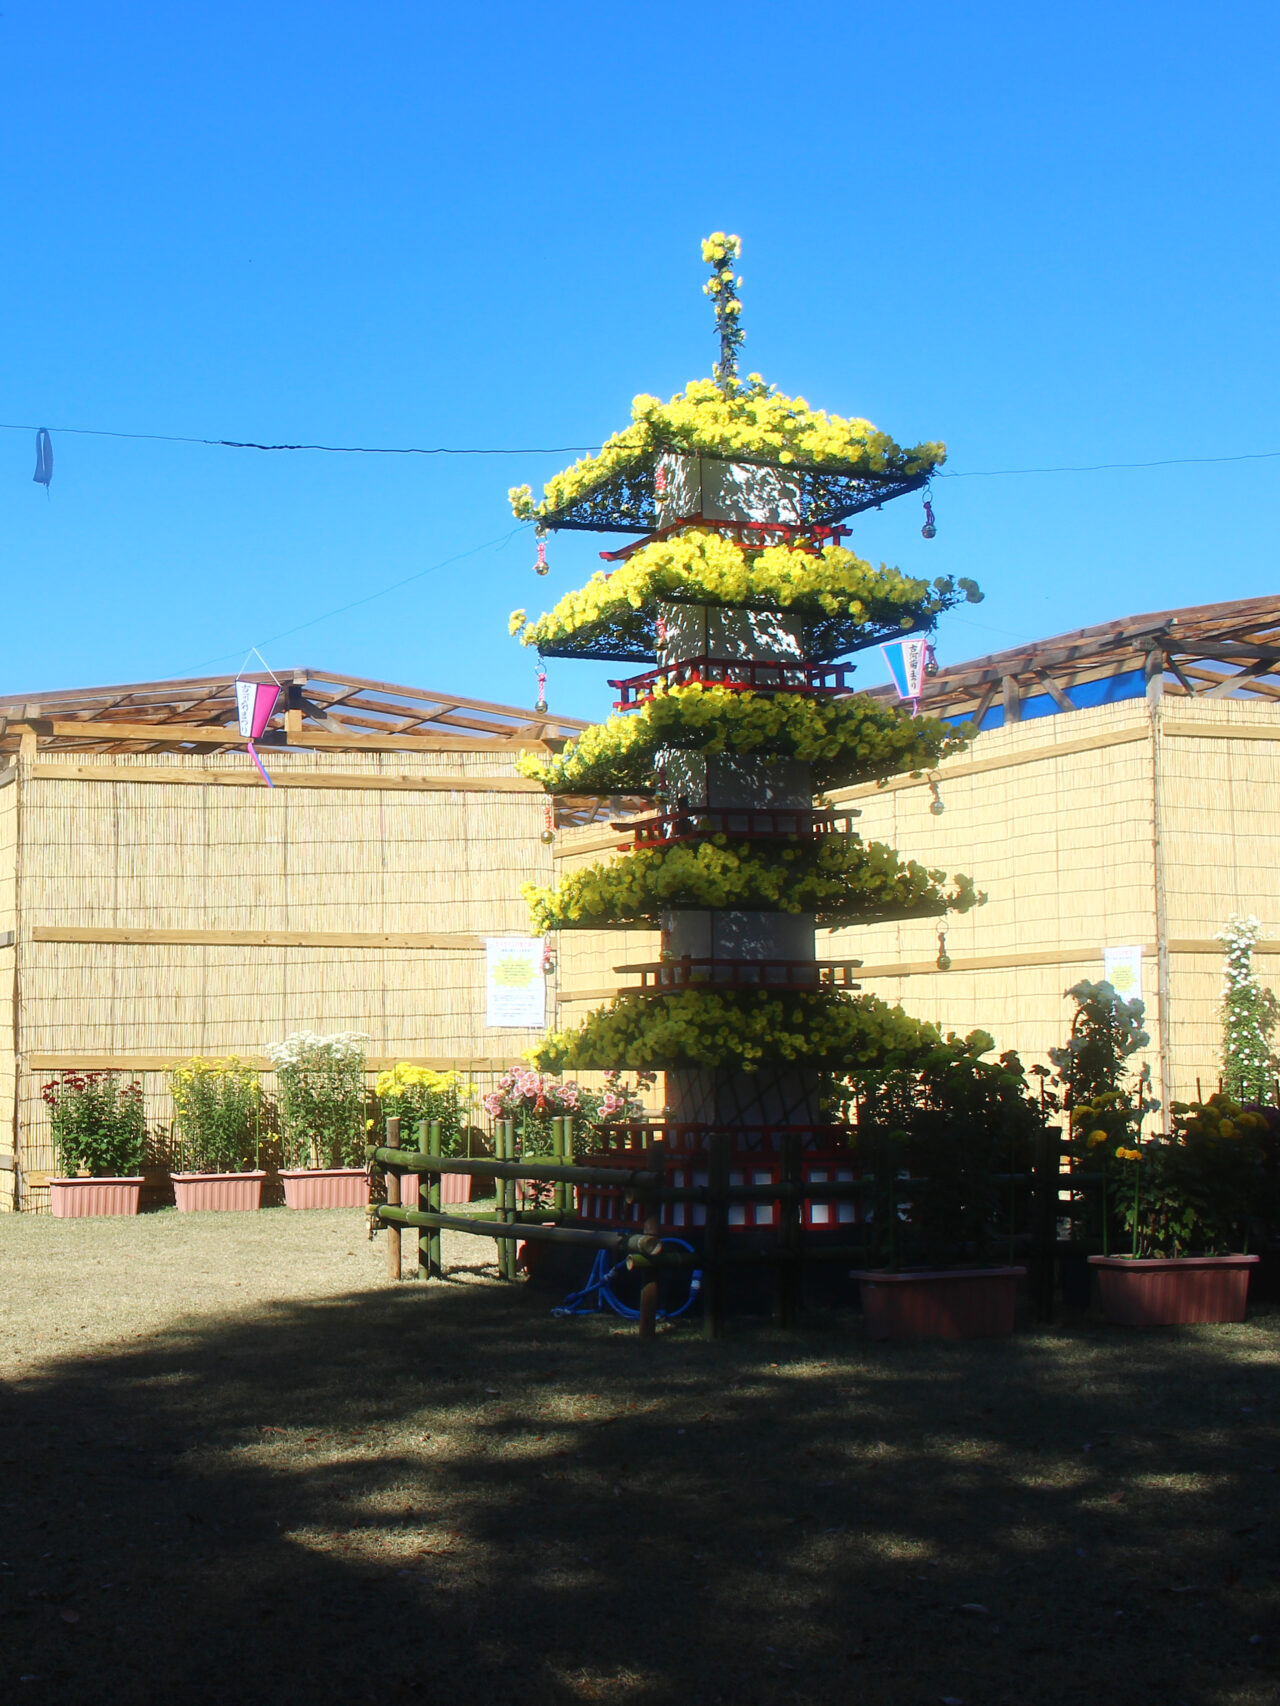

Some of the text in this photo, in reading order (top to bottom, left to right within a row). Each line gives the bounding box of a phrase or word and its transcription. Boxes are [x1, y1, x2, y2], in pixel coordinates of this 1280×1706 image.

[909, 643, 918, 689] 古河菊まつり
[241, 683, 252, 734] 古河菊まつり
